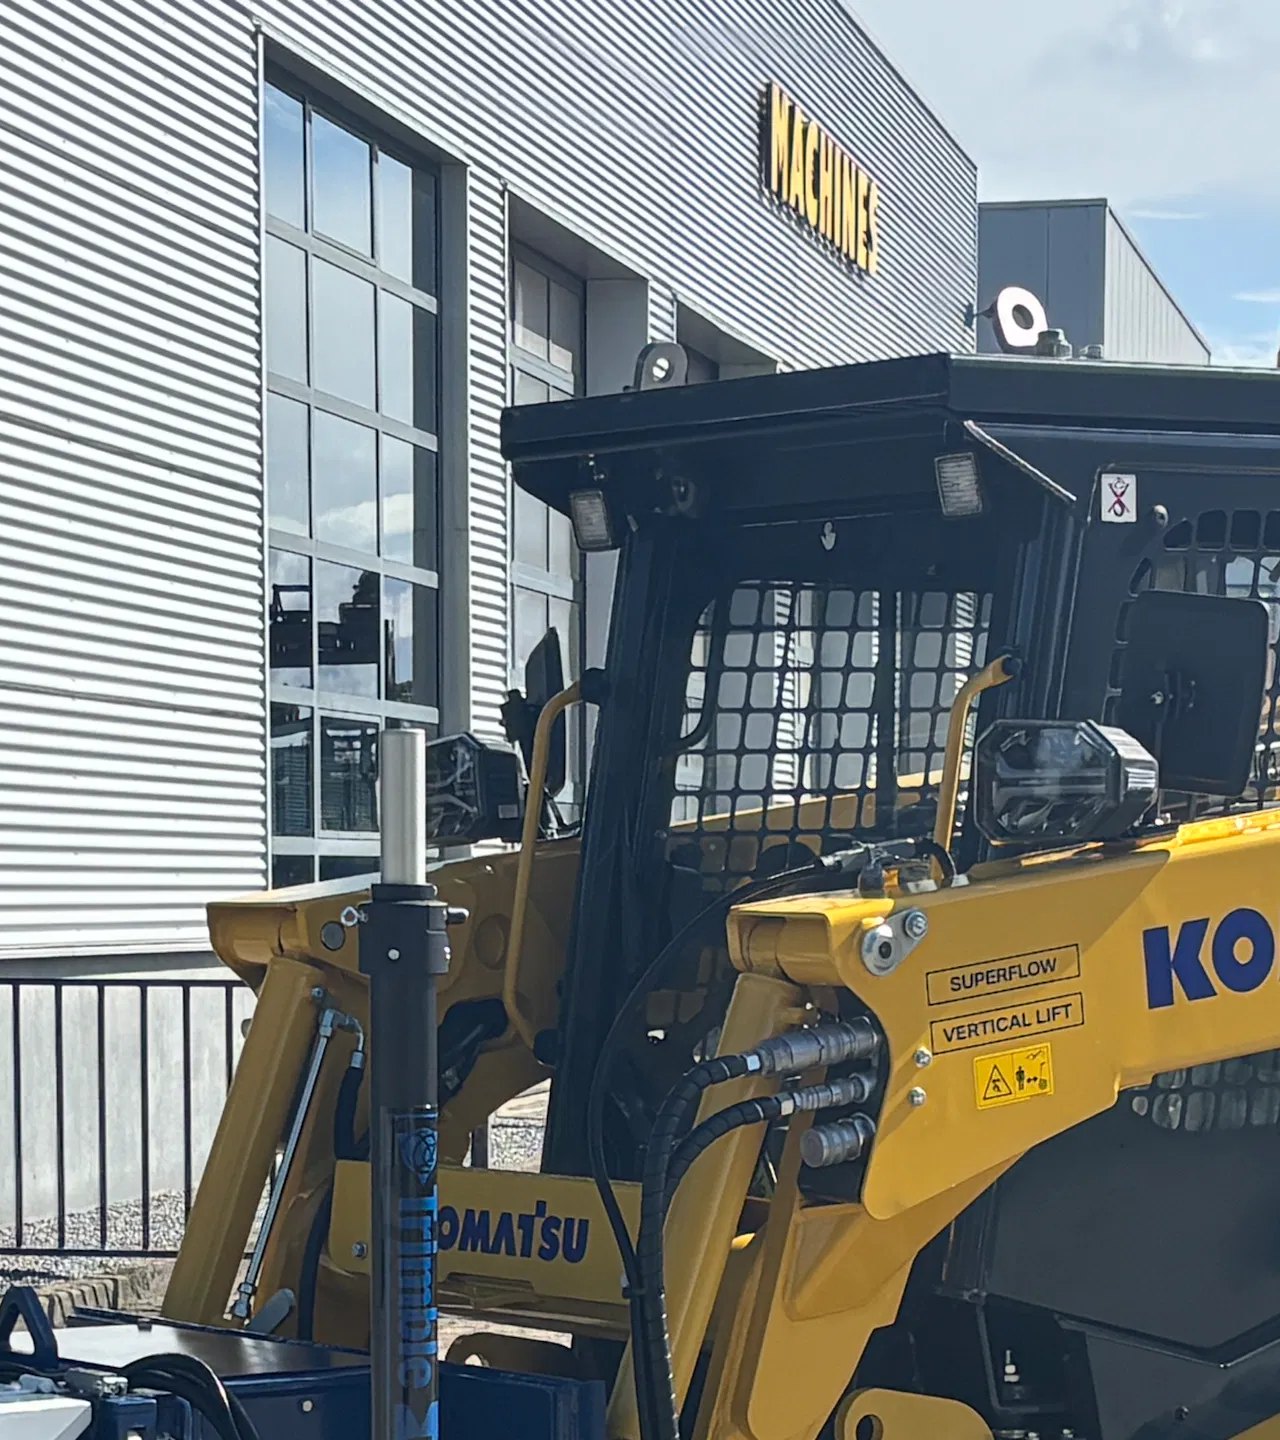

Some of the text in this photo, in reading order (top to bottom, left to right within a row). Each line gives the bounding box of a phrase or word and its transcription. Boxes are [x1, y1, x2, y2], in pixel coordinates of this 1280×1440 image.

[771, 79, 879, 275] MACHINES
[950, 957, 1057, 992] SUPERFLOW
[943, 1003, 1073, 1043] VERTICAL LIFT
[438, 1200, 590, 1264] OMATSU
[399, 1184, 439, 1389] Trimble
